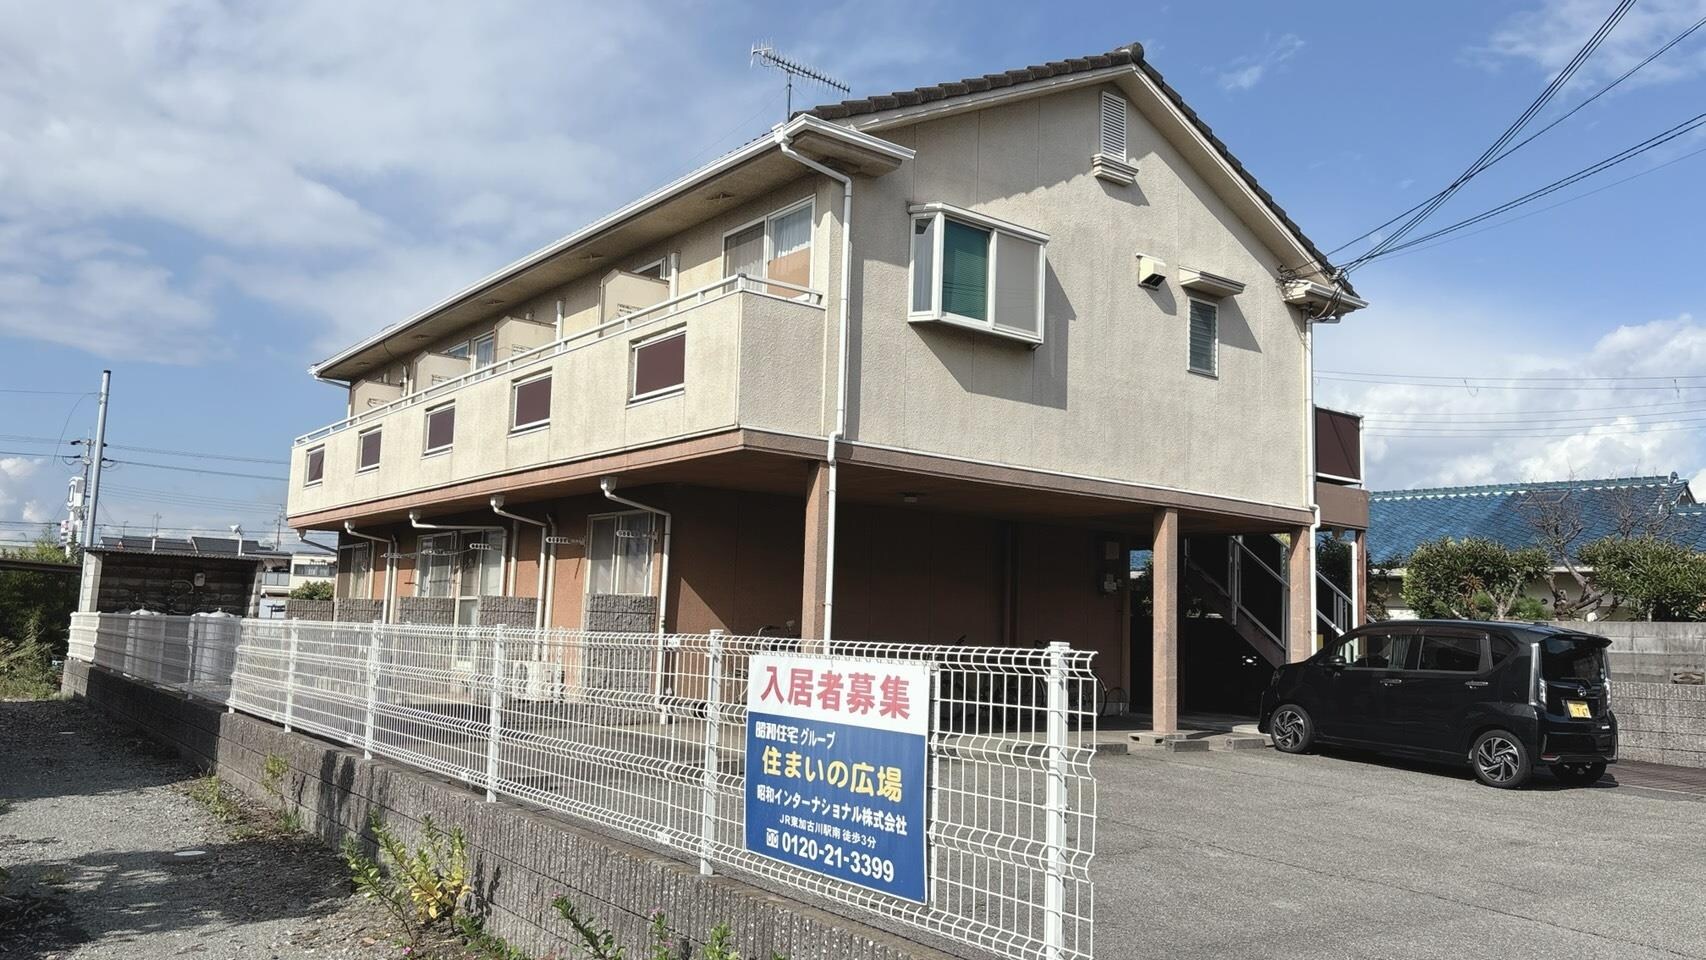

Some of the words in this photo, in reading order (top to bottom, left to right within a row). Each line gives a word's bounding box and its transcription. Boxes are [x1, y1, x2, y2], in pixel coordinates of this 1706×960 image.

[760, 665, 911, 720] 入居者募集
[762, 745, 903, 803] 住まいの広場
[756, 784, 908, 836] 昭和インターナショナル株式会社
[779, 814, 841, 840] JR東加古川駅南
[842, 828, 877, 849] 徒歩3分
[782, 832, 895, 883] 0120-21-3399
